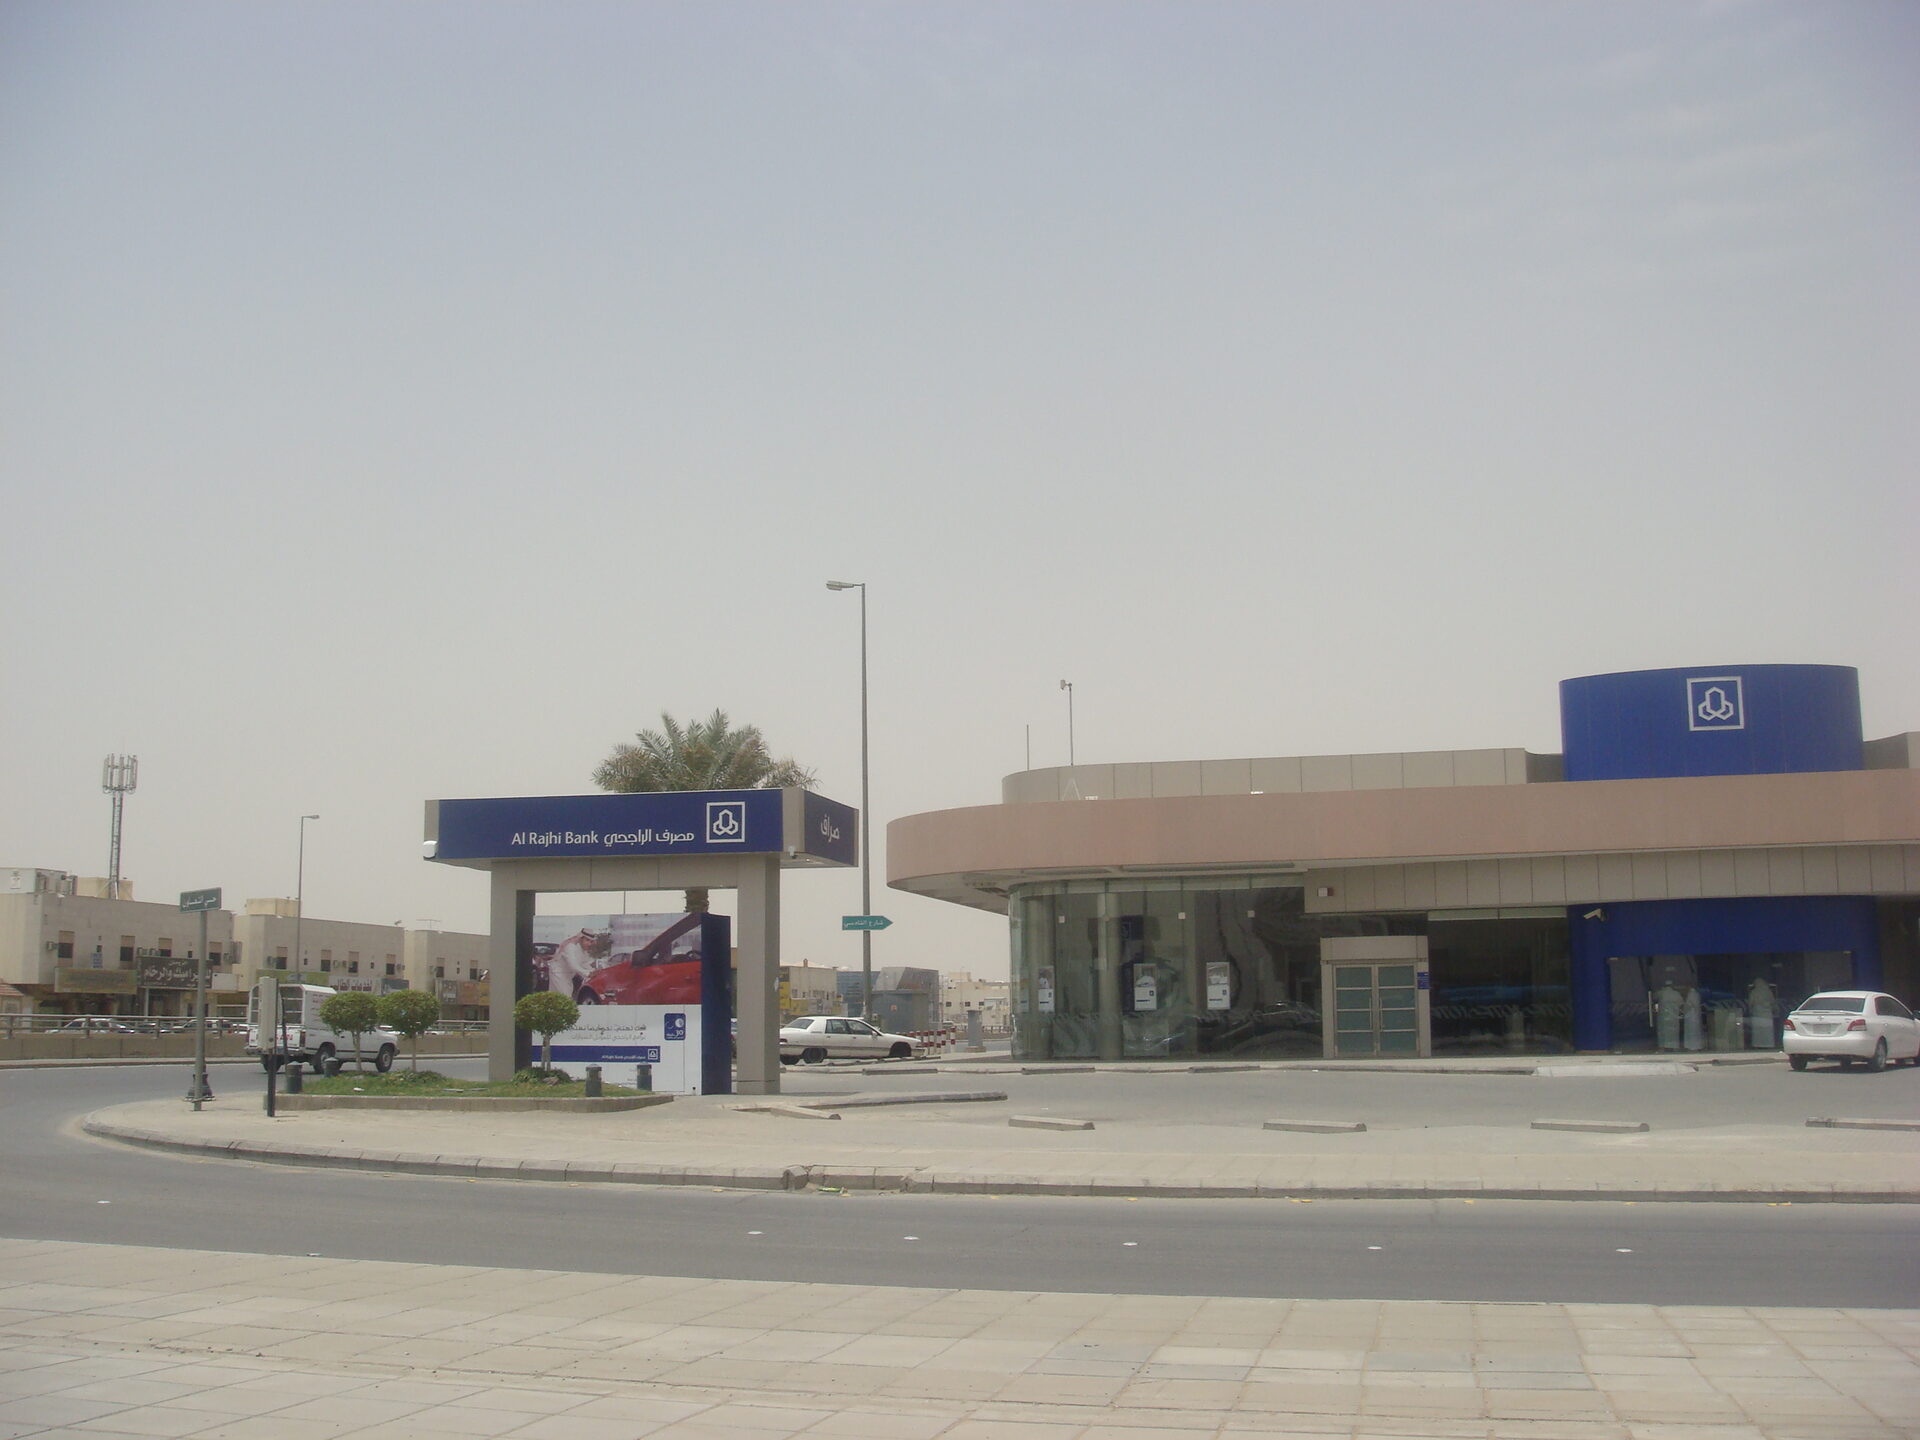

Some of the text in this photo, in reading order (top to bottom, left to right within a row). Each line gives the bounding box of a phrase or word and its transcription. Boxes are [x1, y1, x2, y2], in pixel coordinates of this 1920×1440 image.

[820, 813, 840, 843] صراف
[511, 830, 599, 848] Al Rajhi Bank
[603, 829, 695, 847] مصرف الراجحي
